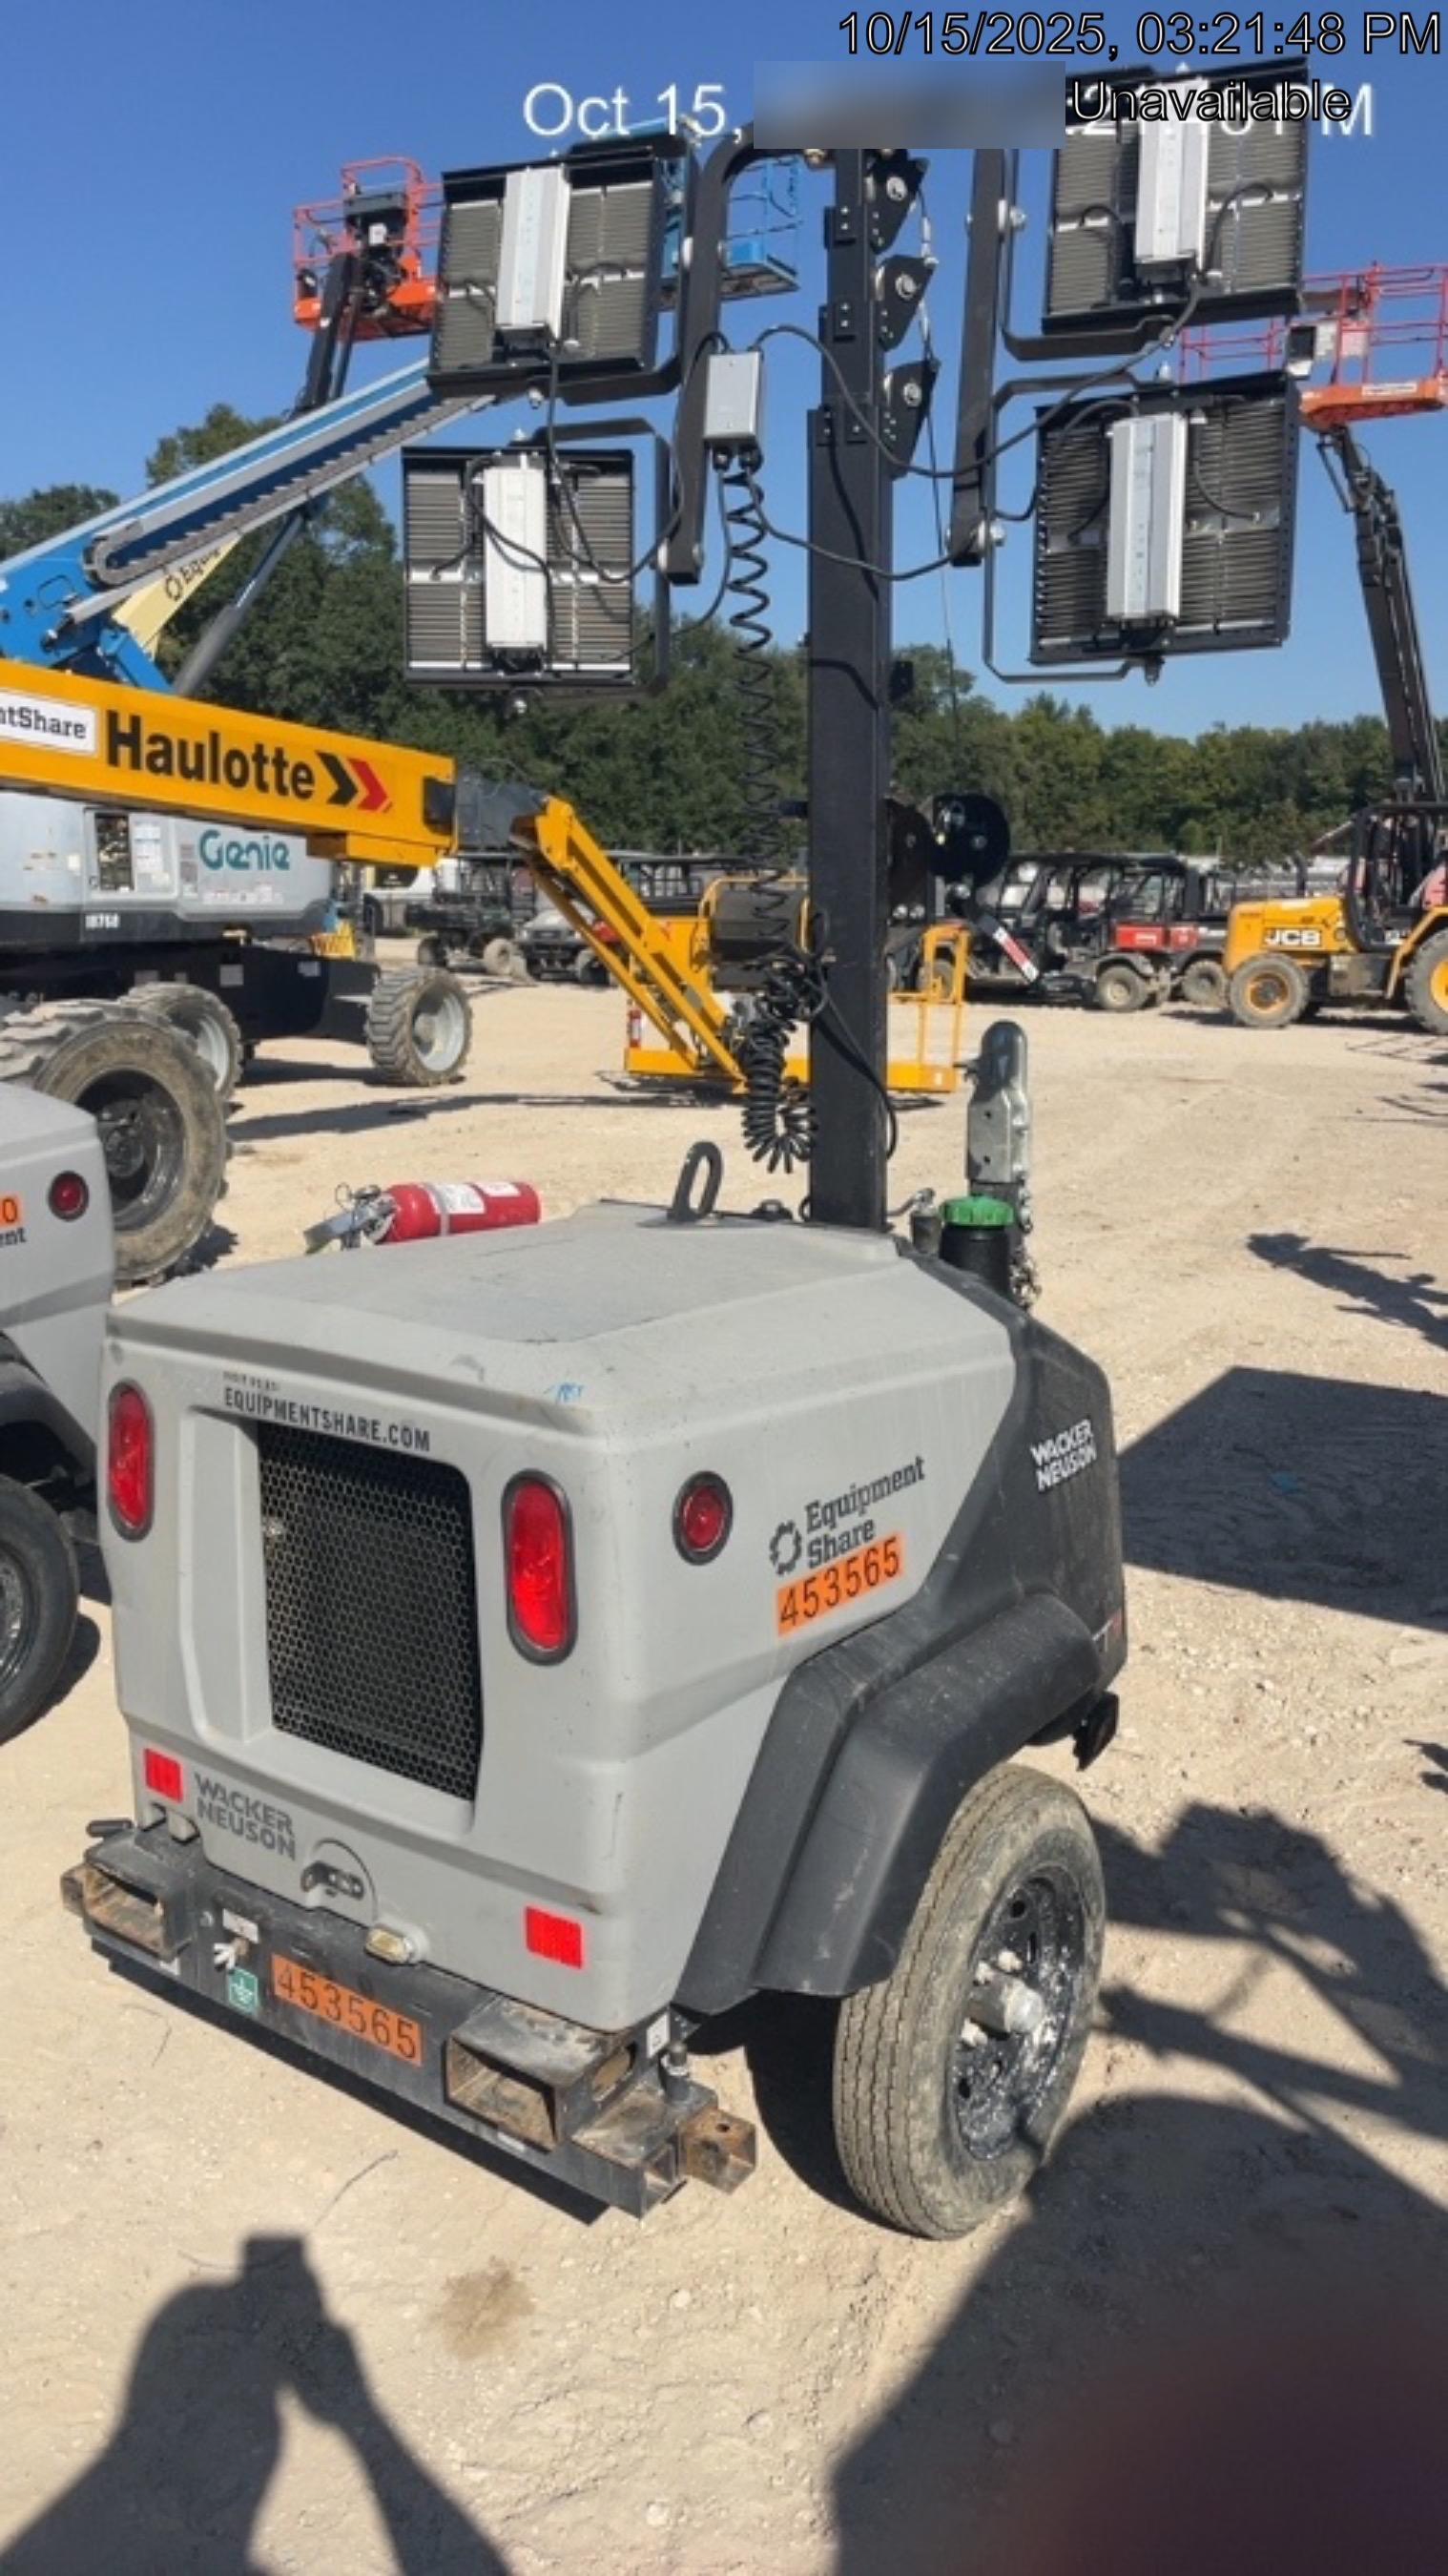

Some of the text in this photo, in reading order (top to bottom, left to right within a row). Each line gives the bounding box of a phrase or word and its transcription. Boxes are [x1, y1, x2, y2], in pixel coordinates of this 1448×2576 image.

[106, 709, 315, 800] Haulotte
[199, 828, 290, 870] Genie
[1265, 929, 1320, 945] JCB
[224, 1386, 430, 1452] EQUIPMENTSHARE.COM
[1030, 1419, 1093, 1466] WACKER
[804, 1454, 925, 1534] Equipment
[1036, 1445, 1097, 1491] NEUSON
[807, 1519, 876, 1569] Share
[780, 1536, 900, 1626] 453565
[194, 1771, 295, 1839] WACKER
[197, 1797, 295, 1862] NEUSON
[278, 1967, 416, 2059] 453565
